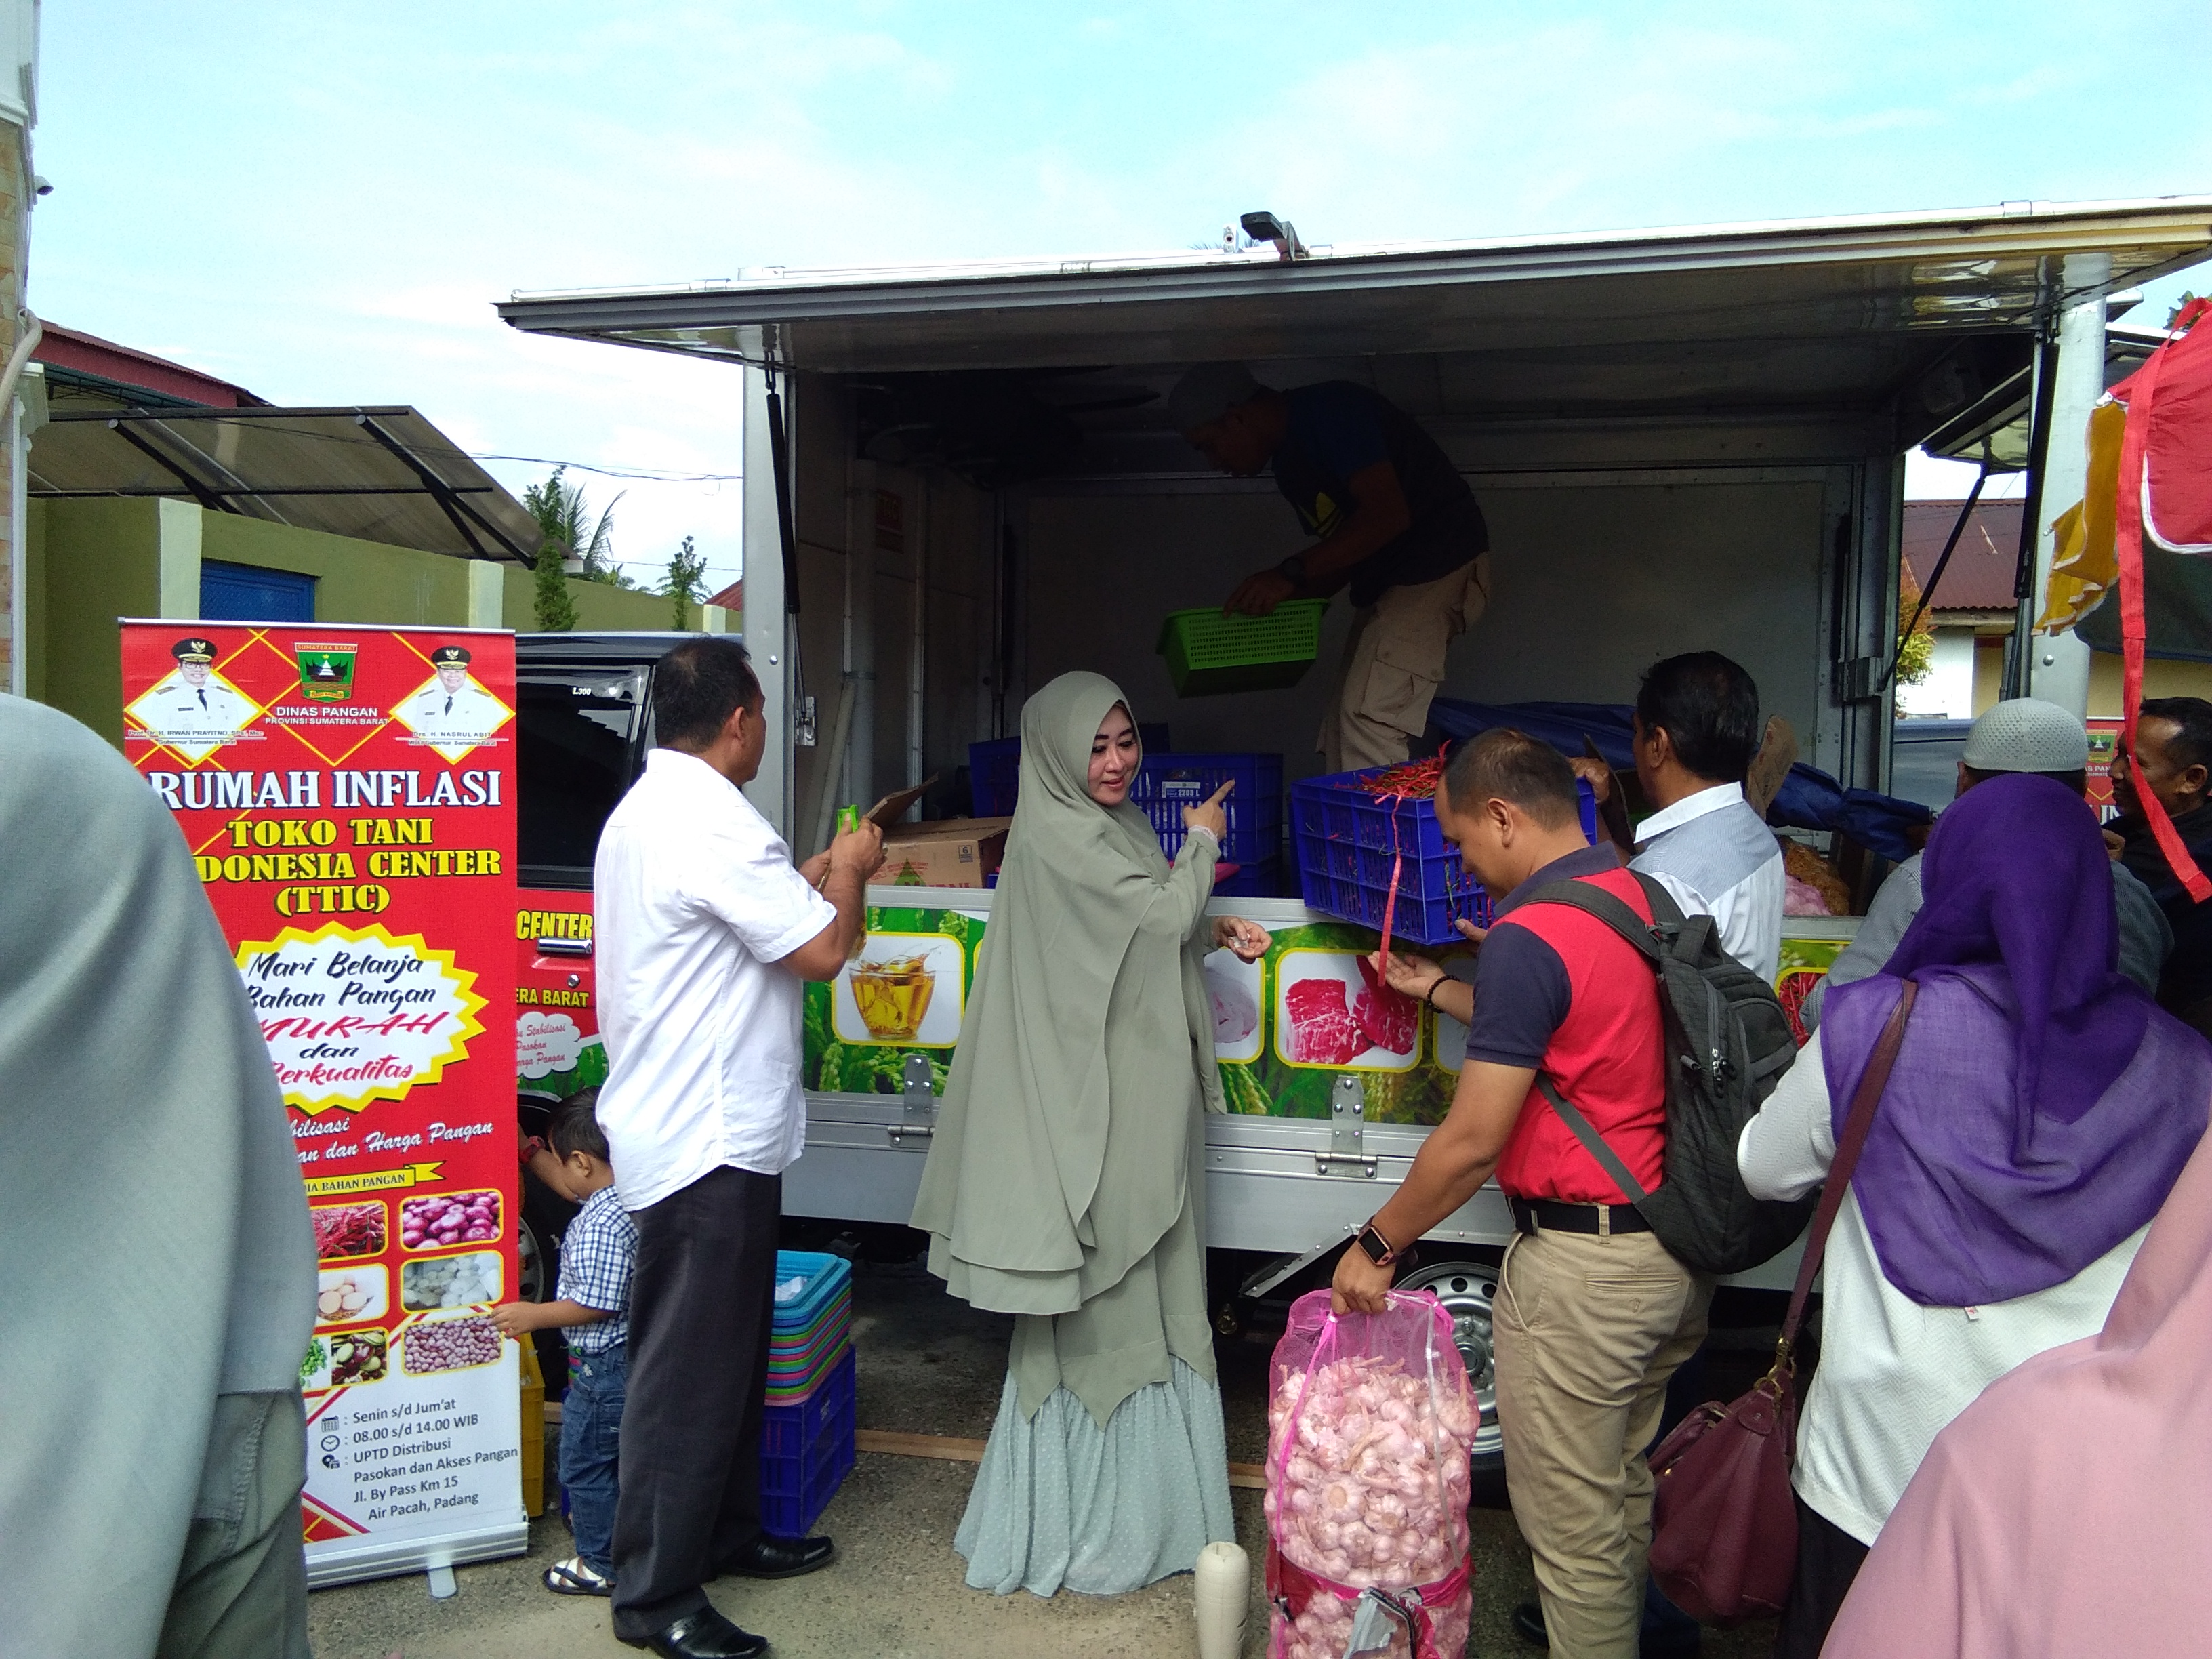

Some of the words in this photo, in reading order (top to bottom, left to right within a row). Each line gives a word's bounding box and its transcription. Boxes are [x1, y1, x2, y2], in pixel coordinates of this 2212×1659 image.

[573, 687, 592, 695] L300
[264, 717, 308, 725] PROVINSI
[276, 706, 319, 717] DINAS
[322, 707, 378, 717] PANGAN
[148, 771, 321, 810] RUMAH
[331, 770, 502, 808] INFLASI
[227, 819, 337, 848] TOKO
[348, 817, 434, 846] TANI
[193, 852, 357, 883] DONESIA
[367, 848, 502, 878] CENTER
[274, 883, 391, 917] (TTIC)
[516, 910, 594, 941] CENTER
[248, 951, 318, 981] Mari
[327, 950, 424, 983] Belanja
[247, 984, 326, 1009] Bahan
[338, 981, 436, 1015] Pangan
[542, 989, 589, 1008] BARAT
[299, 1042, 360, 1059] dan
[323, 1140, 359, 1160] dan
[364, 1130, 424, 1154] Harga
[427, 1122, 495, 1145] Pangan
[321, 1179, 361, 1192] BAHAN
[362, 1174, 406, 1187] PANGAN
[352, 1408, 388, 1424] Senin
[391, 1403, 412, 1419] s/d
[352, 1427, 389, 1443] 08.00
[391, 1422, 412, 1439] s/d
[416, 1418, 451, 1435] 14.00
[453, 1414, 479, 1429] WIB
[353, 1447, 389, 1464] UPTD
[392, 1437, 451, 1458] Distribusi
[354, 1466, 407, 1483] Pasokan
[409, 1461, 433, 1475] dan
[436, 1456, 472, 1471] Akses
[474, 1448, 518, 1465] Pangan
[354, 1490, 367, 1503] Jl.
[370, 1488, 387, 1502] By
[390, 1484, 417, 1497] Pass
[419, 1479, 441, 1492] Km
[443, 1475, 459, 1489] 15
[368, 1506, 388, 1521] Air
[390, 1499, 431, 1517] Pacah,
[434, 1493, 480, 1510] Padang
